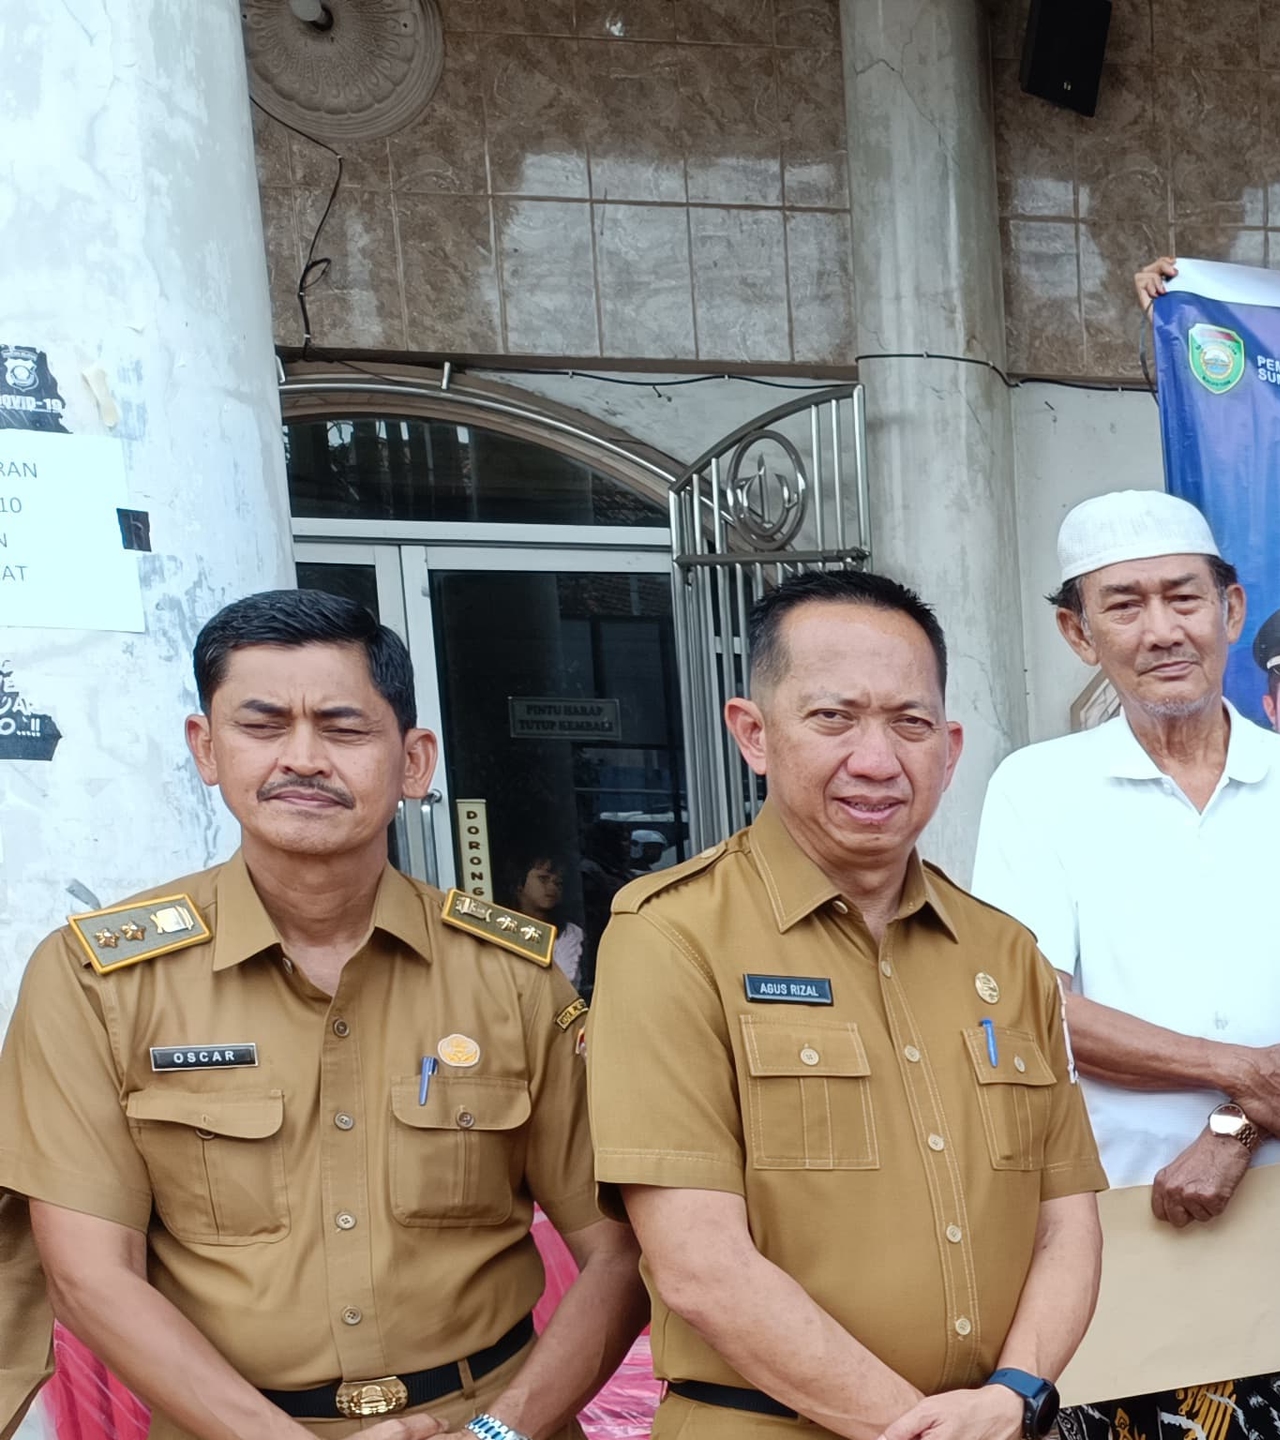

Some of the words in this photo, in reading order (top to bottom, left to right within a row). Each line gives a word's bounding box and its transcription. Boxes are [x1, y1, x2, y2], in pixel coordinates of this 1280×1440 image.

[0, 394, 63, 412] OVID-19
[526, 705, 562, 716] PINTU
[564, 705, 604, 717] HARAP
[519, 719, 555, 731] TUTUP
[466, 810, 485, 896] DORONG
[760, 983, 787, 995] AGUS
[790, 984, 819, 997] RIZAL
[173, 1050, 235, 1063] OSCAR
